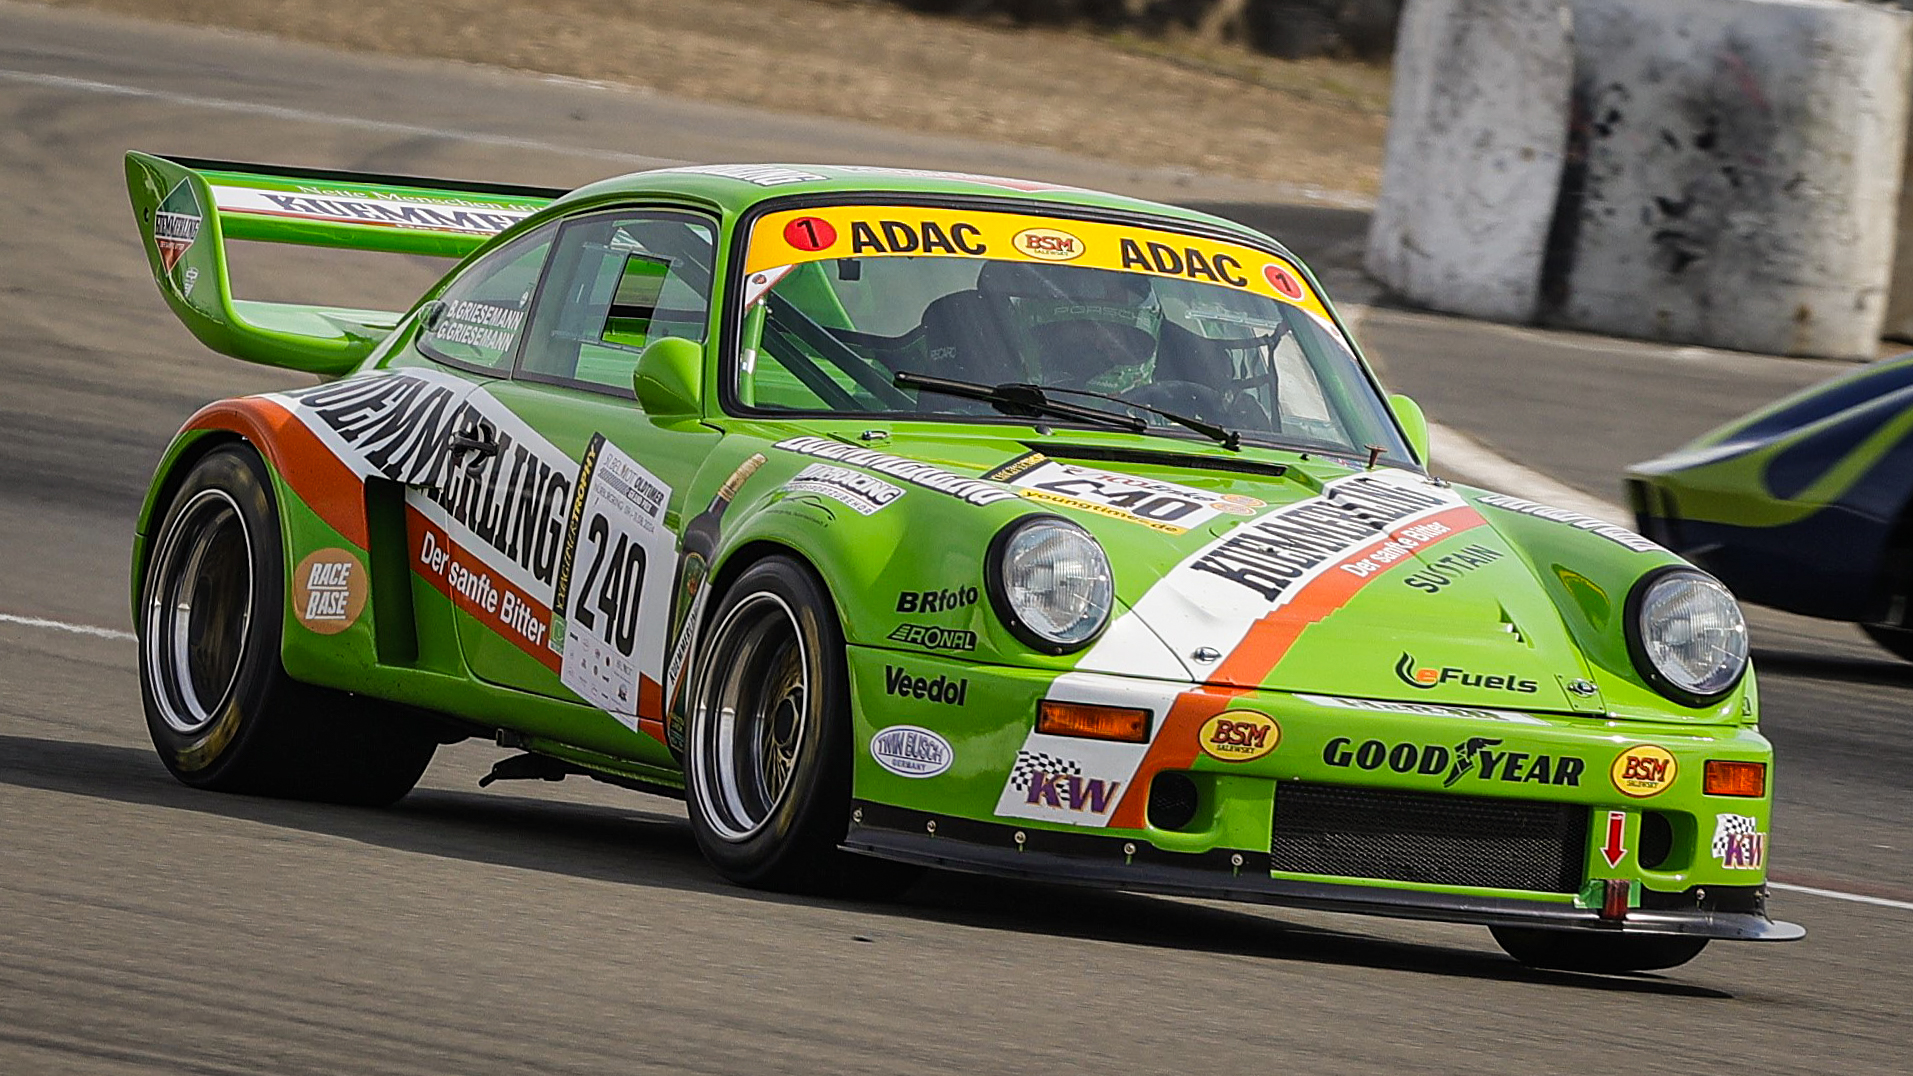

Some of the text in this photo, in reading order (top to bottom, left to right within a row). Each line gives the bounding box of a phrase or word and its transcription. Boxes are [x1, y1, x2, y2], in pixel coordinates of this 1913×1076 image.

[297, 185, 368, 200] Nette
[372, 191, 502, 211] Menschen
[797, 220, 820, 248] 1
[851, 221, 987, 255] ADAC
[1025, 234, 1075, 252] BSM
[1120, 238, 1248, 288] ADAC
[447, 300, 525, 331] B.GRIESEMANN
[437, 320, 514, 352] G.GRIESEMANN
[300, 375, 571, 587] UEMMERLING
[633, 476, 665, 506] OLDTIMER
[1035, 479, 1203, 521] 240
[1189, 477, 1448, 603] KUEMMERLING
[1340, 556, 1383, 578] Der
[1400, 521, 1452, 542] Bitter
[308, 563, 351, 586] RACE
[420, 530, 547, 646] Der sanfte Bitter
[575, 512, 648, 657] 240
[306, 591, 350, 618] BASE
[896, 586, 978, 613] BRfoto
[907, 628, 974, 649] RONAL
[885, 664, 969, 706] Veedol
[1415, 667, 1538, 693] eFuels
[878, 732, 943, 763] TWIN BUSCH
[1210, 719, 1271, 748] BSM
[891, 759, 926, 772] GERMANY
[1623, 755, 1670, 782] BSM
[1026, 770, 1121, 815] KW
[1723, 833, 1767, 869] KW
